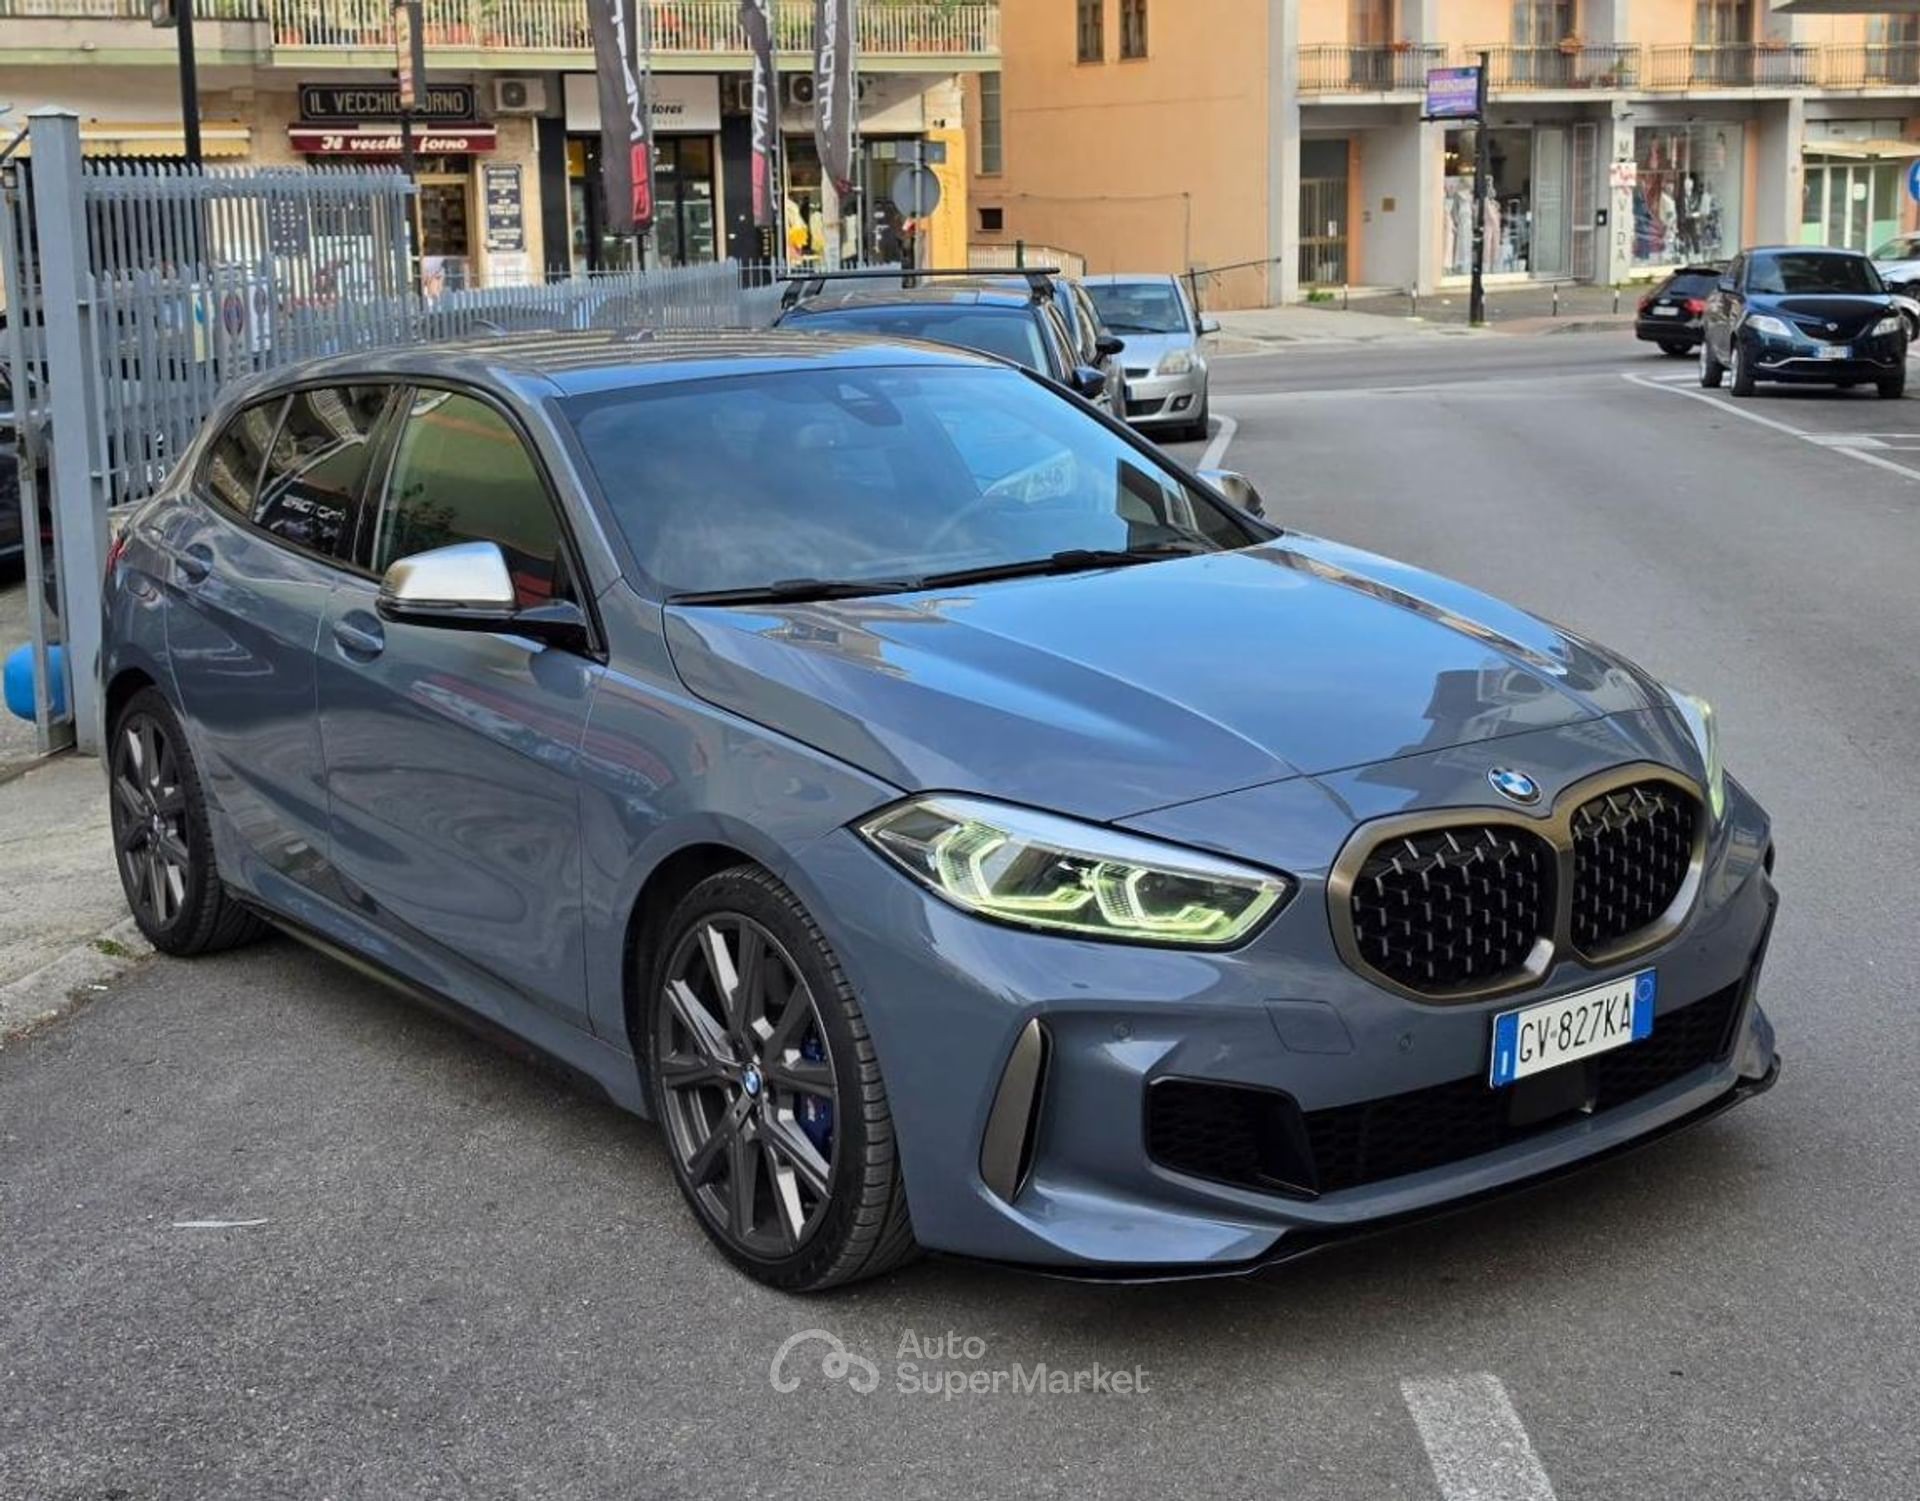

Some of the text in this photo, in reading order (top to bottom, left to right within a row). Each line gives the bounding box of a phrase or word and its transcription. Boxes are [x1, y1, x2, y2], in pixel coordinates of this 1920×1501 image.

[309, 91, 326, 113] IL
[425, 91, 465, 113] ORNO
[321, 136, 469, 153] Il vecchi forno
